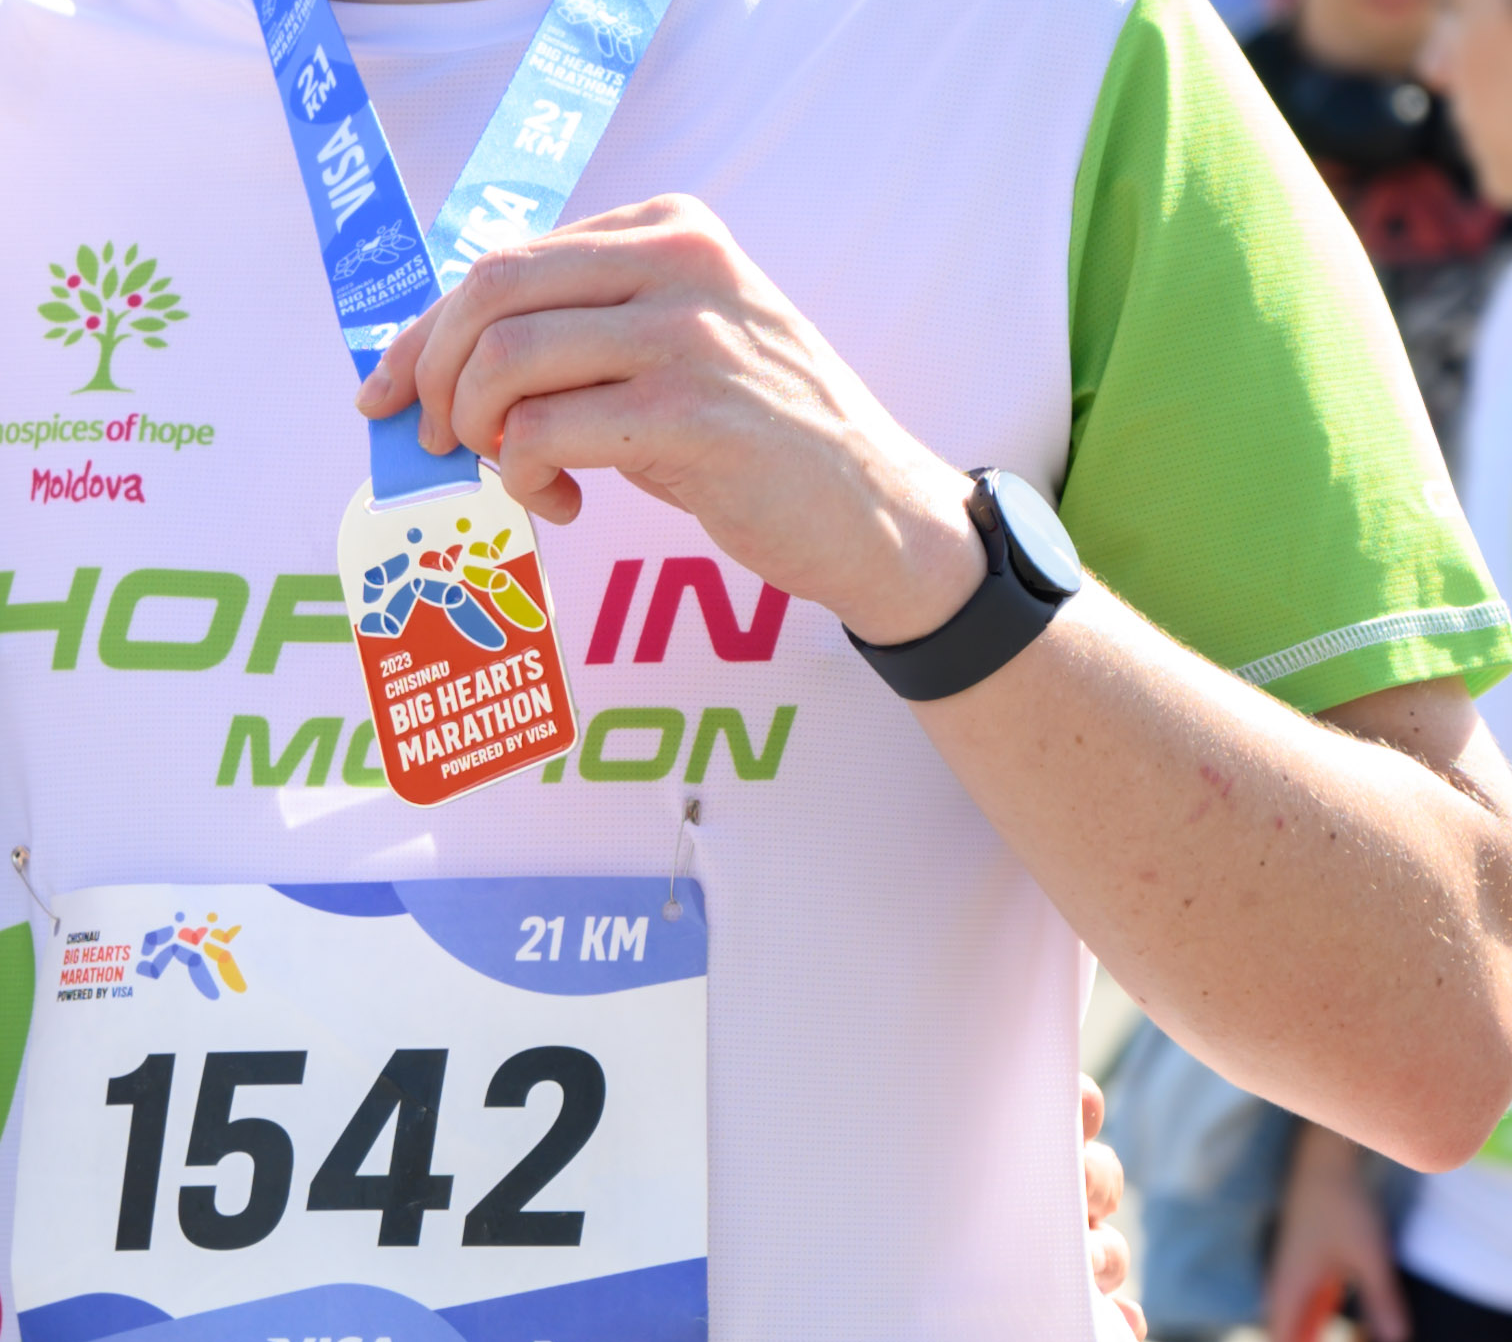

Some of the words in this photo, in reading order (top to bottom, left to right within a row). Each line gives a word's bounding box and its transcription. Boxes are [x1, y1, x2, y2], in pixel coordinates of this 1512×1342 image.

[298, 43, 329, 104] 21
[529, 54, 620, 97] MARATHON
[563, 54, 625, 86] HEARTS
[306, 68, 336, 121] KM
[523, 99, 582, 142] 21
[514, 127, 571, 162] KM
[317, 114, 376, 234] VISA
[338, 291, 363, 308] BIG
[366, 254, 423, 296] HEARTS
[341, 265, 428, 316] MARATHON
[30, 460, 145, 504] Moldova
[584, 557, 792, 666] IN
[380, 652, 412, 678] 2023
[385, 661, 450, 699] CHISINAU
[389, 693, 435, 735] BIG
[437, 649, 544, 717] HEARTS
[397, 683, 553, 772] MARATHON
[441, 742, 503, 779] POWERED
[506, 733, 523, 752] BY
[526, 721, 558, 744] VISA
[63, 948, 80, 966] BIG
[82, 945, 131, 963] HEARTS
[515, 916, 564, 962] 21
[580, 916, 650, 962] KM
[57, 988, 93, 1002] POWERED
[96, 987, 108, 999] BY
[112, 986, 133, 998] VISA
[60, 966, 124, 986] MARATHON
[106, 1045, 606, 1251] 1542
